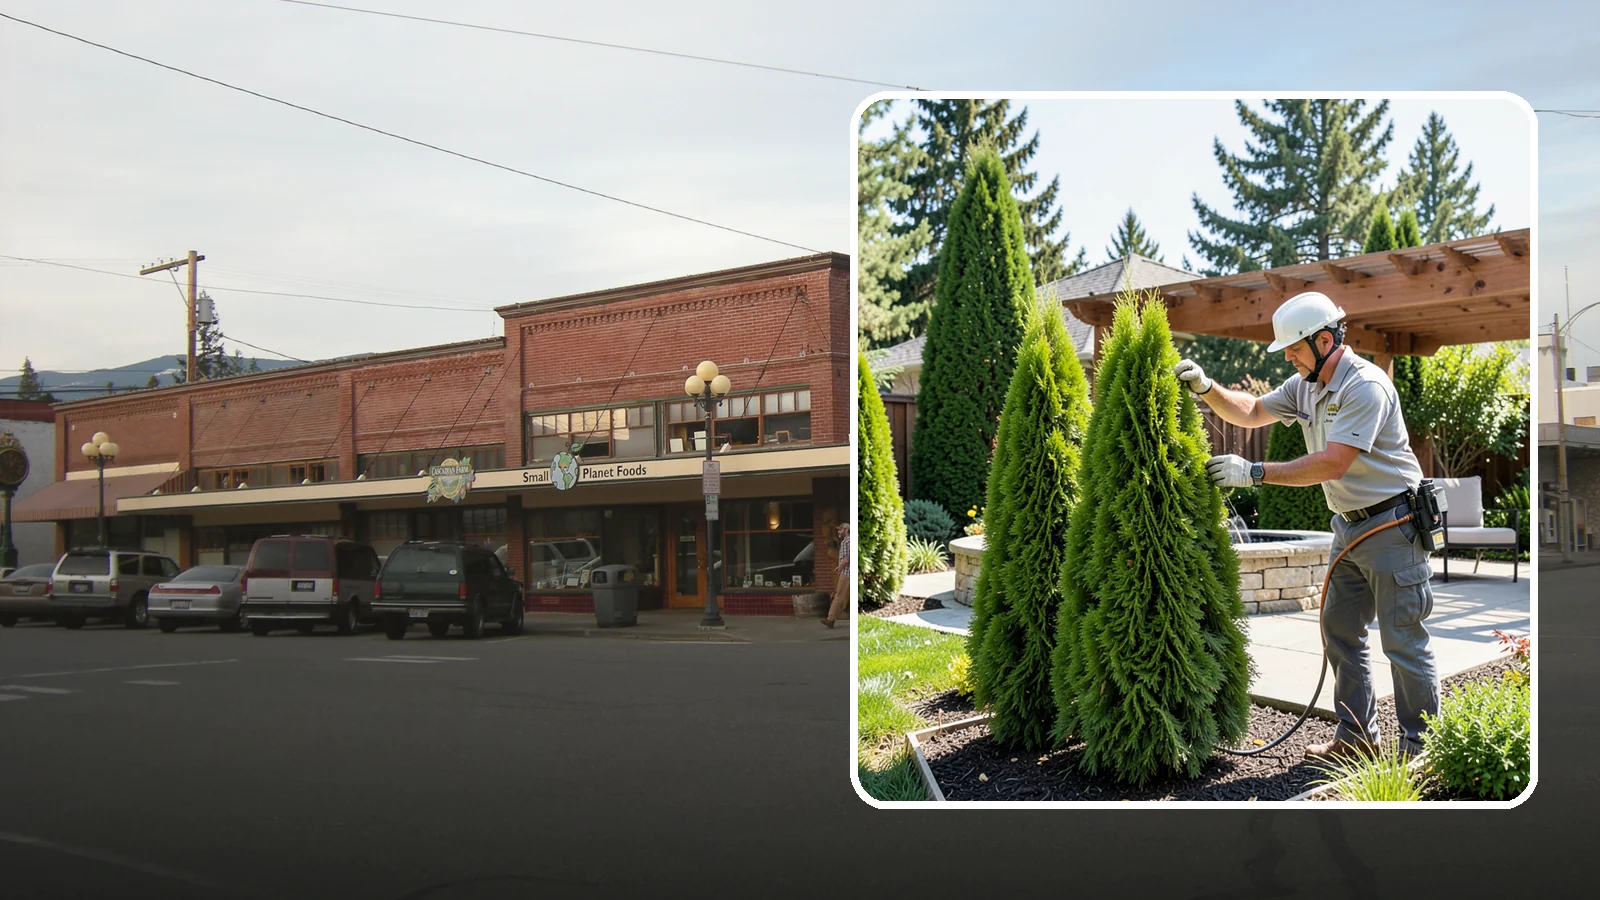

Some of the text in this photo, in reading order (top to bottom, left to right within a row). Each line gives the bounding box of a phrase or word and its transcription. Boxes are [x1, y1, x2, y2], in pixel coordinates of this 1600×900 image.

[523, 464, 647, 483] Small Planet Foods
